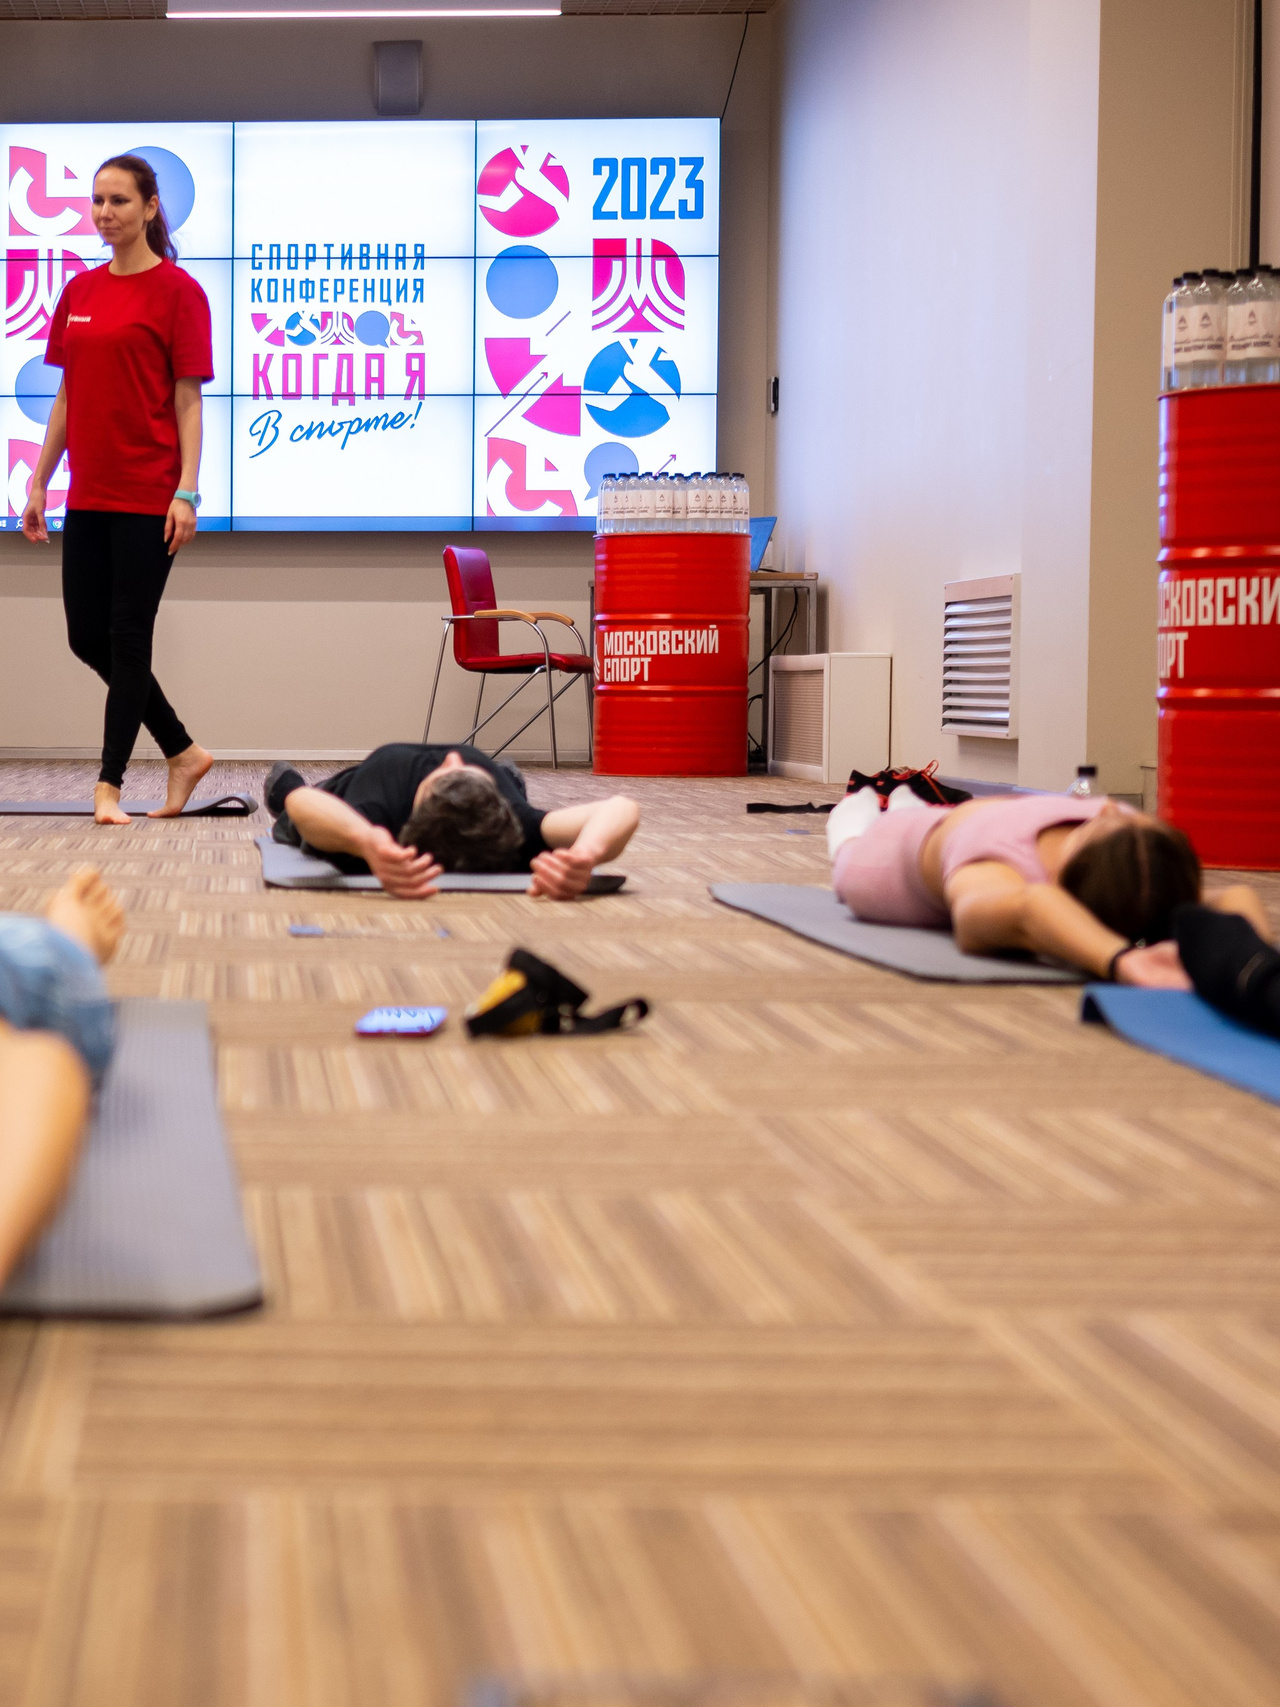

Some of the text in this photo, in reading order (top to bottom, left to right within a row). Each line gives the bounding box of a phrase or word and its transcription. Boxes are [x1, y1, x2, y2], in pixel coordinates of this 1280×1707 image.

[592, 156, 705, 220] 2023
[251, 243, 425, 270] СПОРТИВНАЯ
[251, 278, 424, 306] КОНФЕРЕНЦИЯ
[252, 352, 426, 406] КОГДА Я
[248, 401, 423, 459] В спорте!
[604, 624, 719, 656] МОСКОВСКИЙ
[604, 657, 651, 682] СПОРТ
